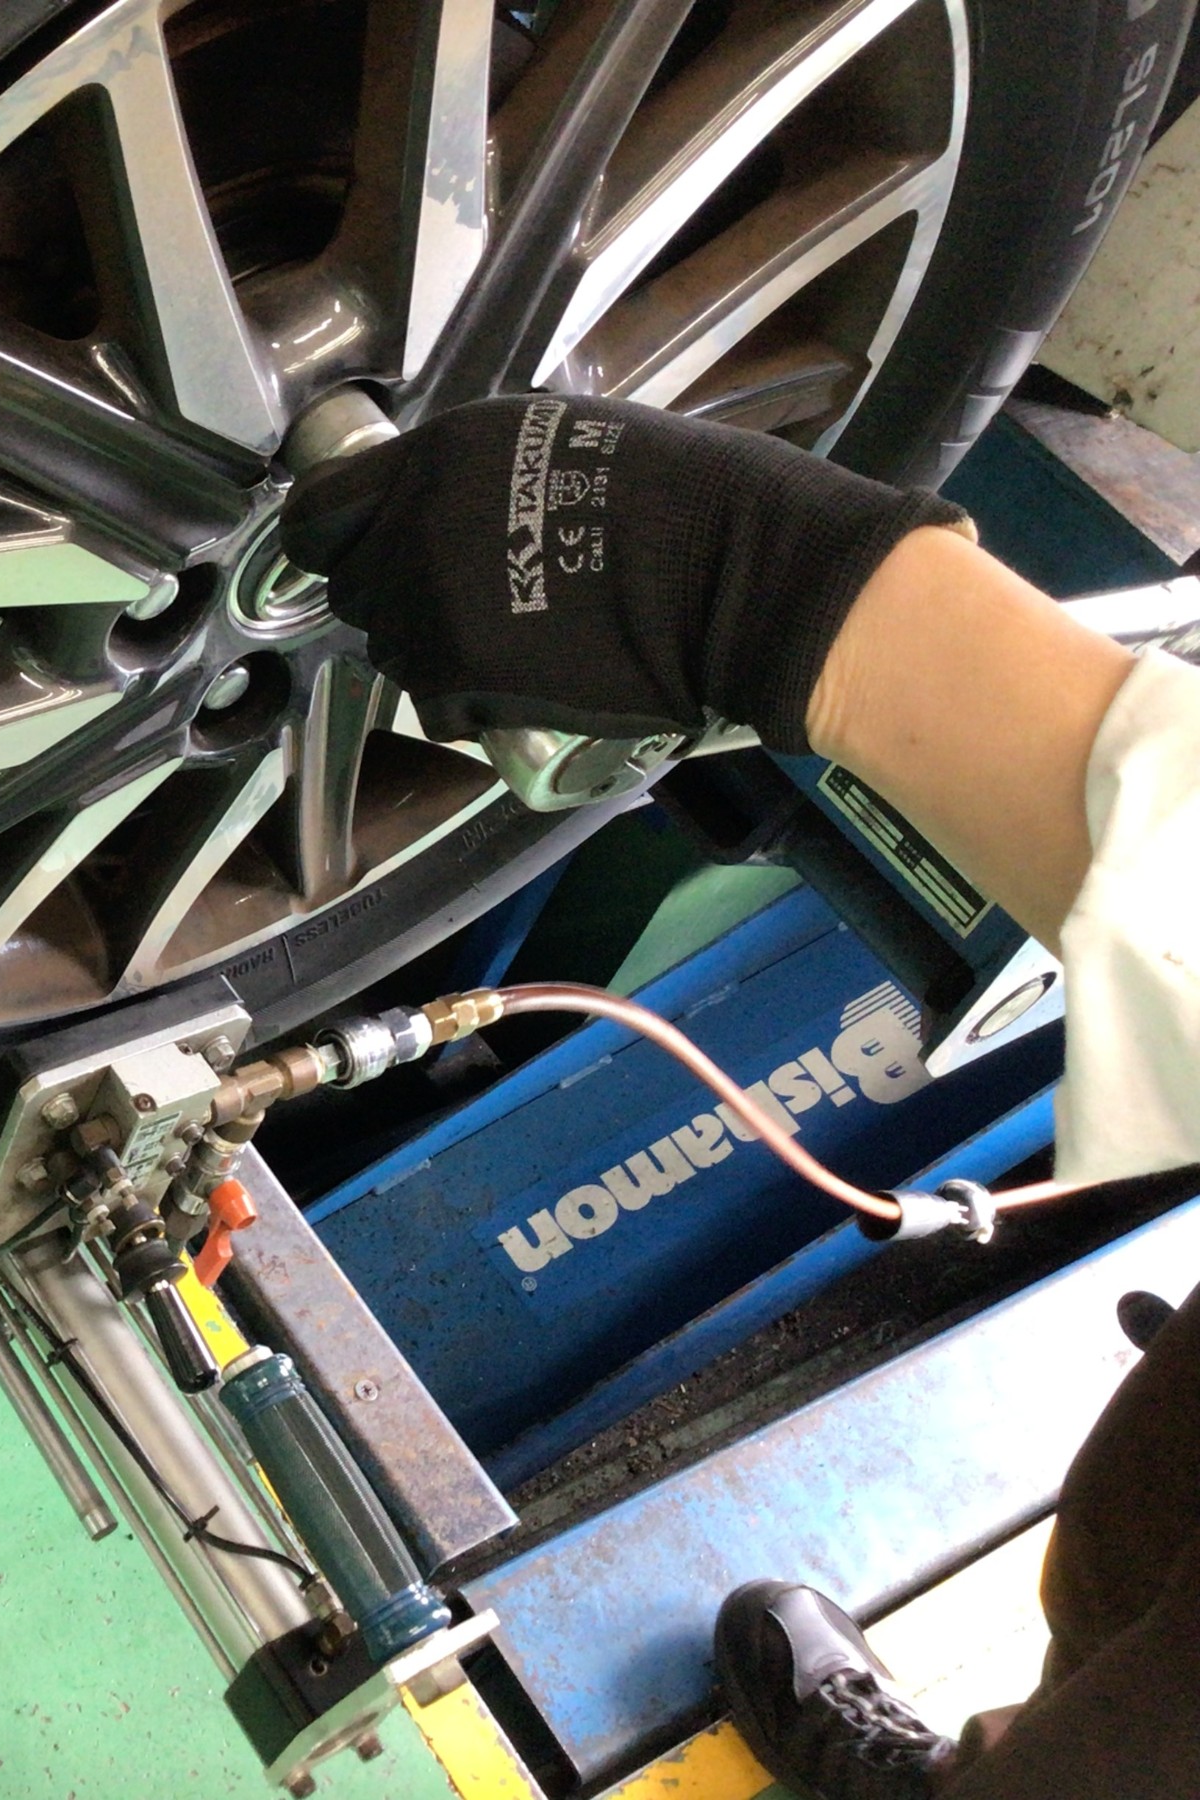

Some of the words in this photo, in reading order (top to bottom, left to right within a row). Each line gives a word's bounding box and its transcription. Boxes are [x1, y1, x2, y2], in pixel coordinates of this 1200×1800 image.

[515, 402, 557, 517] TAKUMI
[569, 420, 607, 448] M
[293, 889, 384, 948] TUBELESS
[498, 981, 934, 1272] Bishamon
